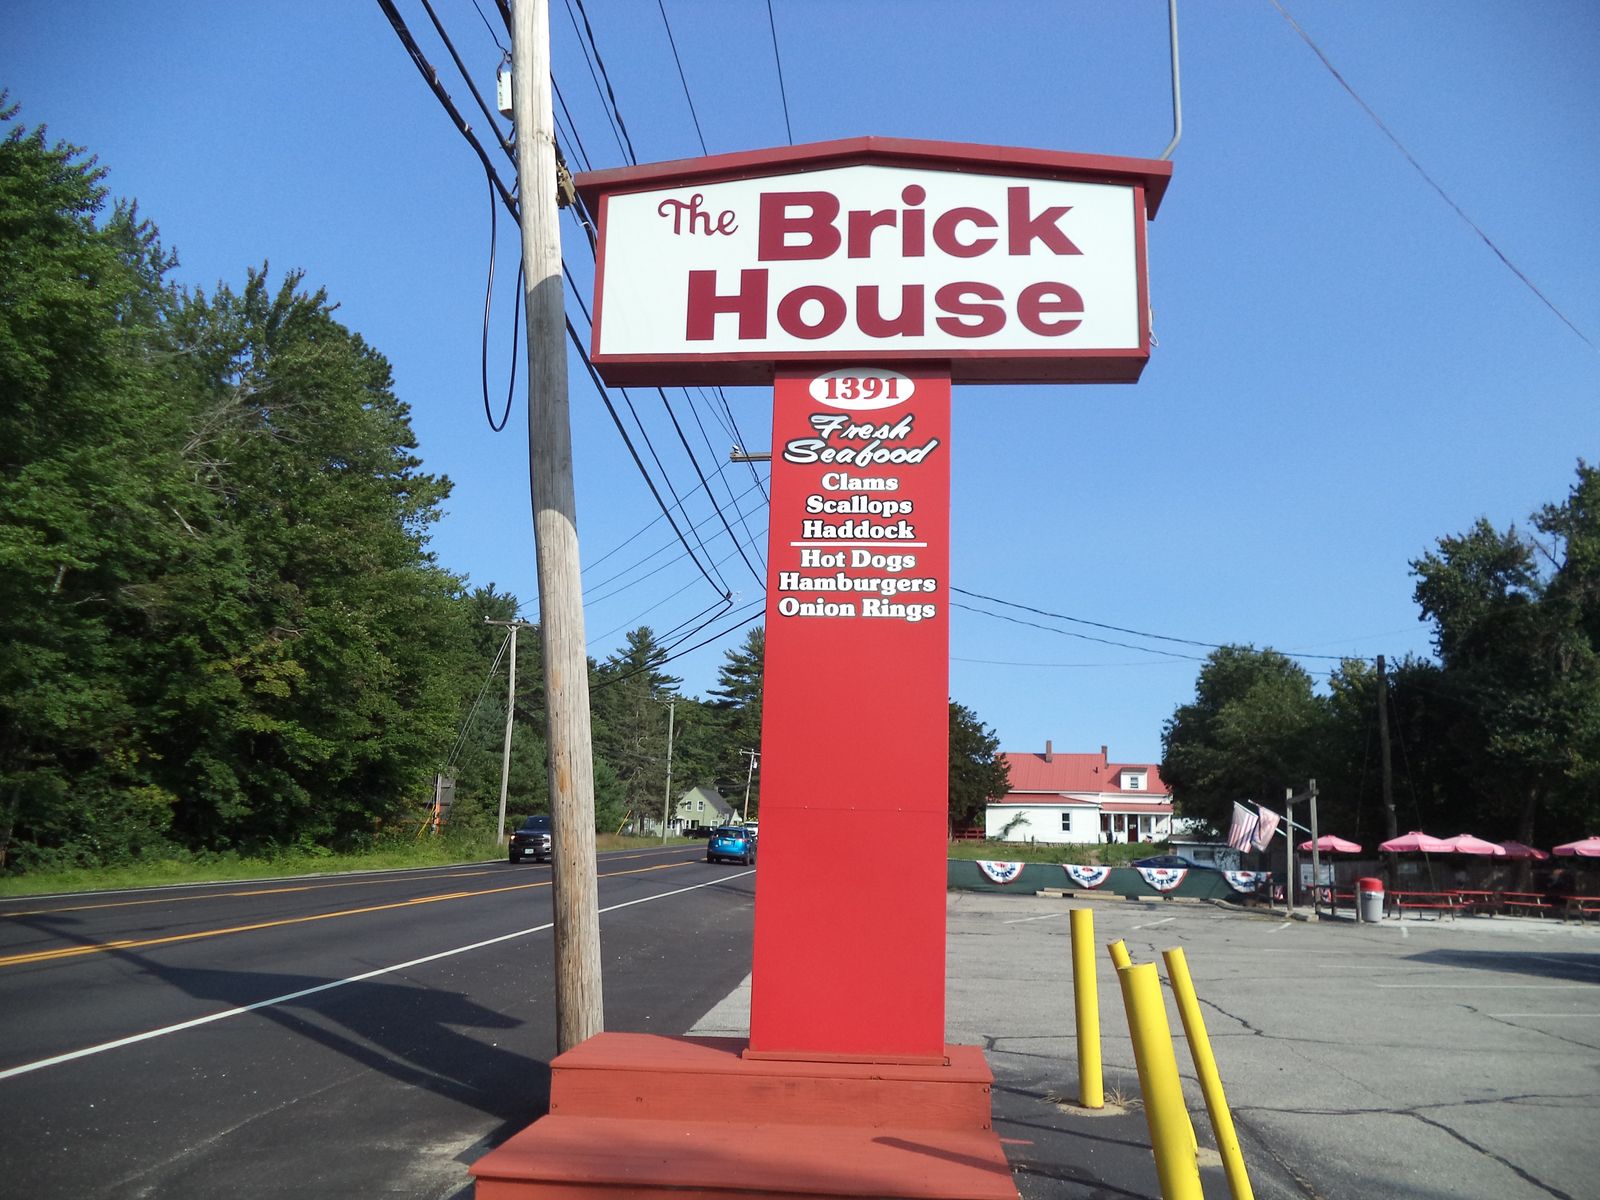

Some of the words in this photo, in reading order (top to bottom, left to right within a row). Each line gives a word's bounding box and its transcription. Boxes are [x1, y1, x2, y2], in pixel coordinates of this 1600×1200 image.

[657, 194, 739, 237] The
[758, 184, 1084, 261] Brick
[686, 268, 1085, 340] House
[823, 377, 899, 400] 1391
[809, 413, 913, 440] Fresh
[783, 438, 940, 468] Seafood
[821, 472, 899, 491] Clams
[805, 495, 913, 518] Scallops
[801, 519, 916, 539] Haddock
[800, 549, 846, 568] Hot
[850, 549, 916, 572] Dogs
[778, 571, 937, 596] Hamburgers
[777, 596, 856, 617] Onion
[861, 597, 936, 622] Rings
